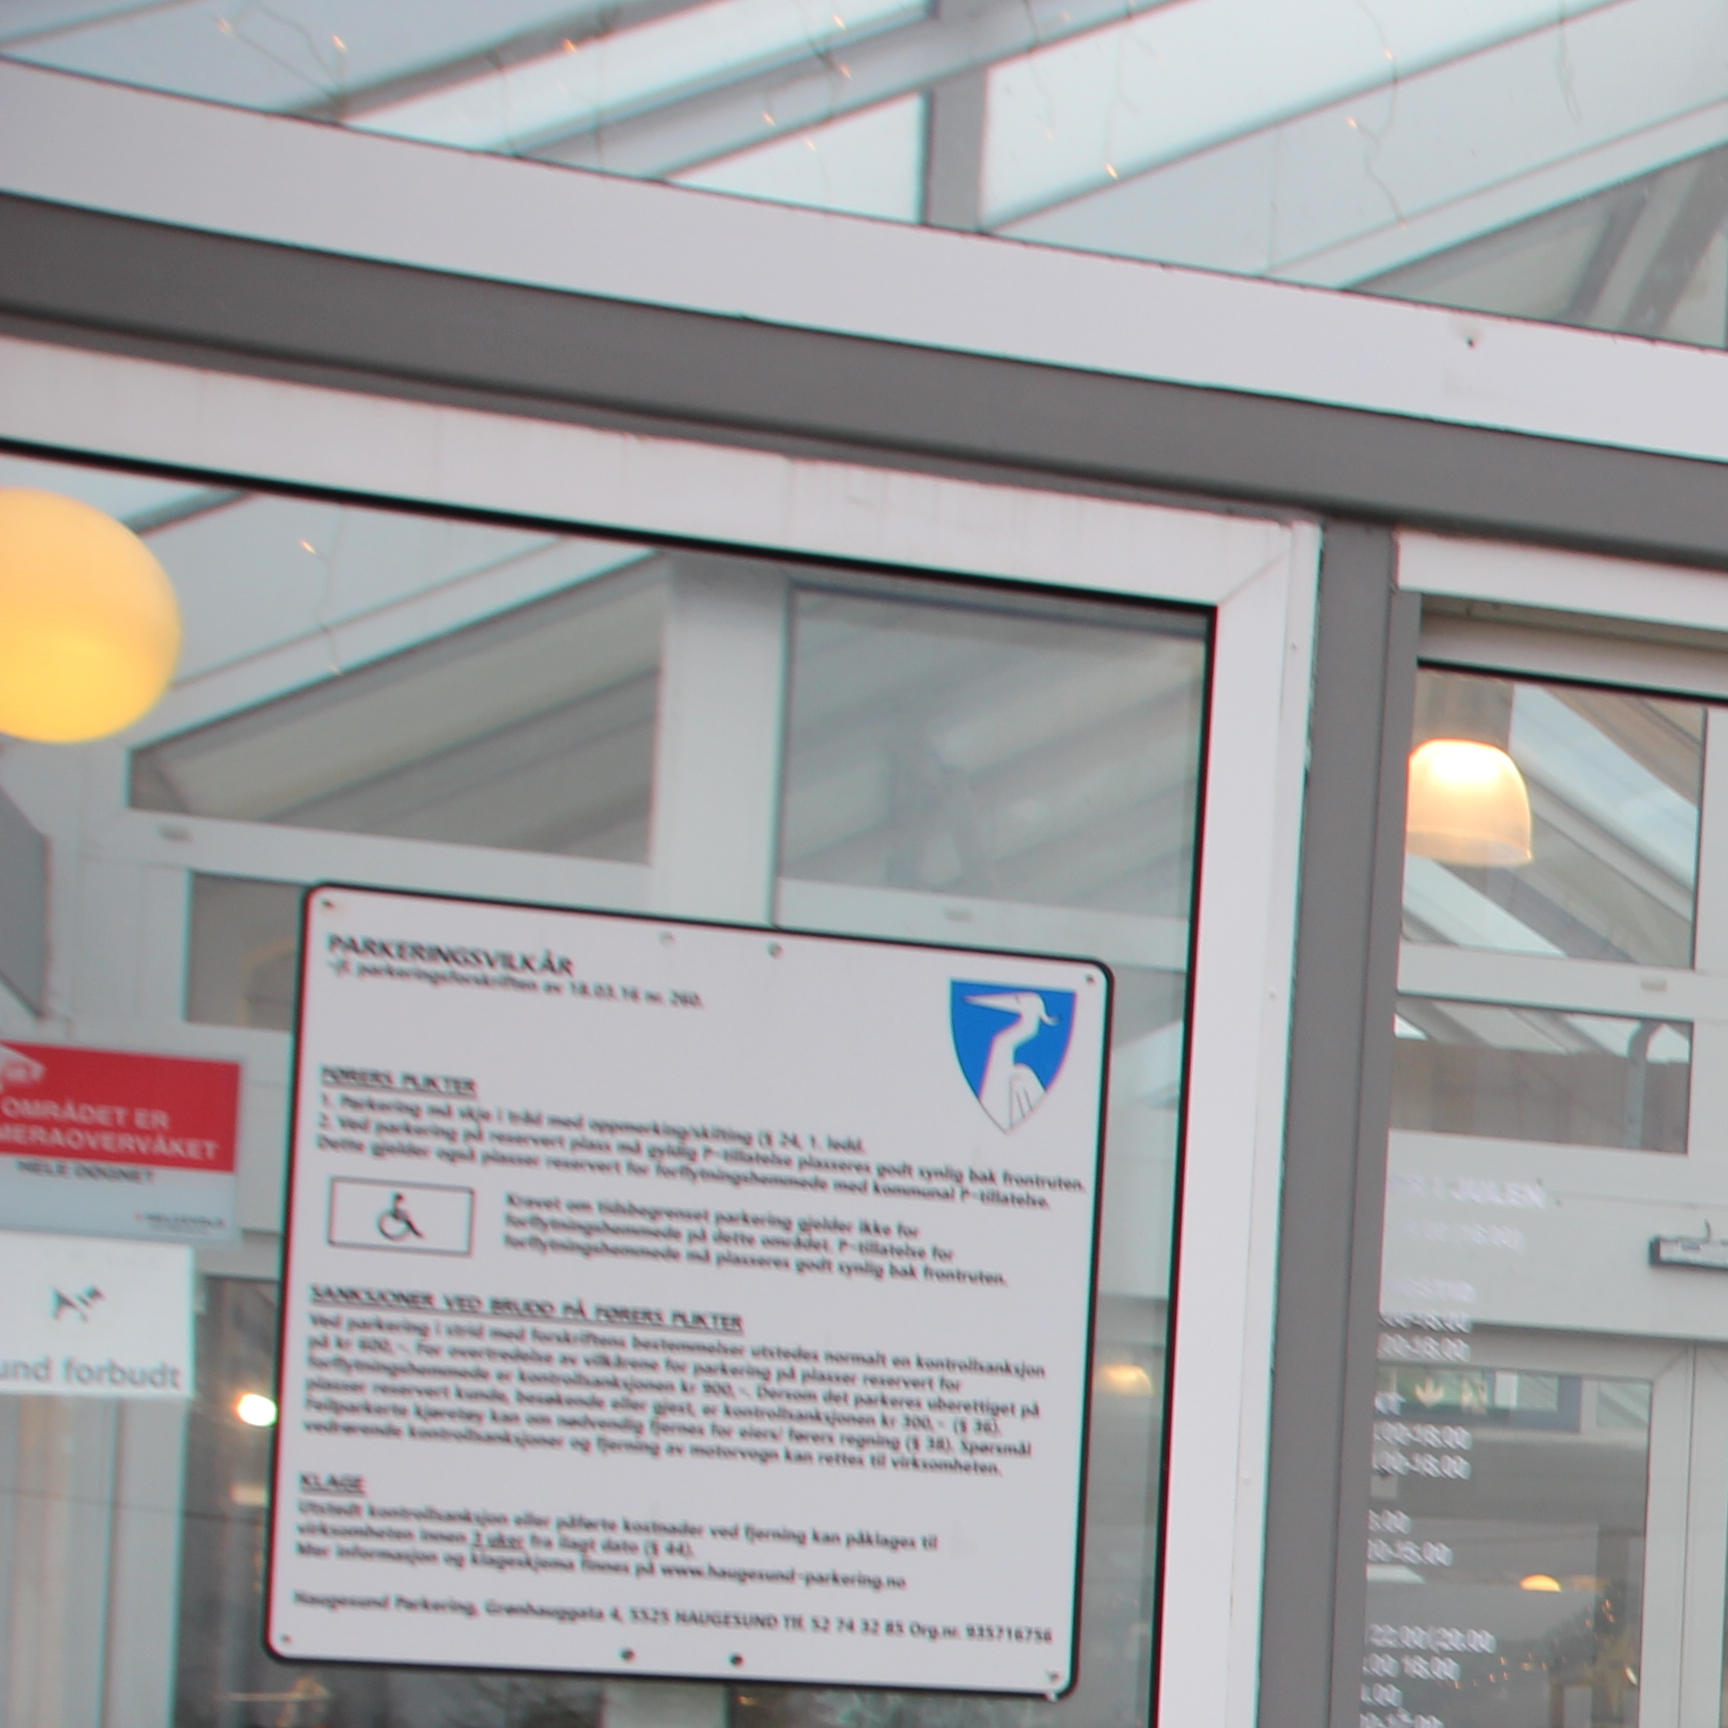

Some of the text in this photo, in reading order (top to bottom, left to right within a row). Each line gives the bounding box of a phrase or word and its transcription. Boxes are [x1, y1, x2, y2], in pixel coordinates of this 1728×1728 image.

[328, 931, 573, 975] PARKERINGSVILKÅR
[1, 1097, 170, 1130] OMRÅDET ER
[62, 1354, 181, 1389] forbudt
